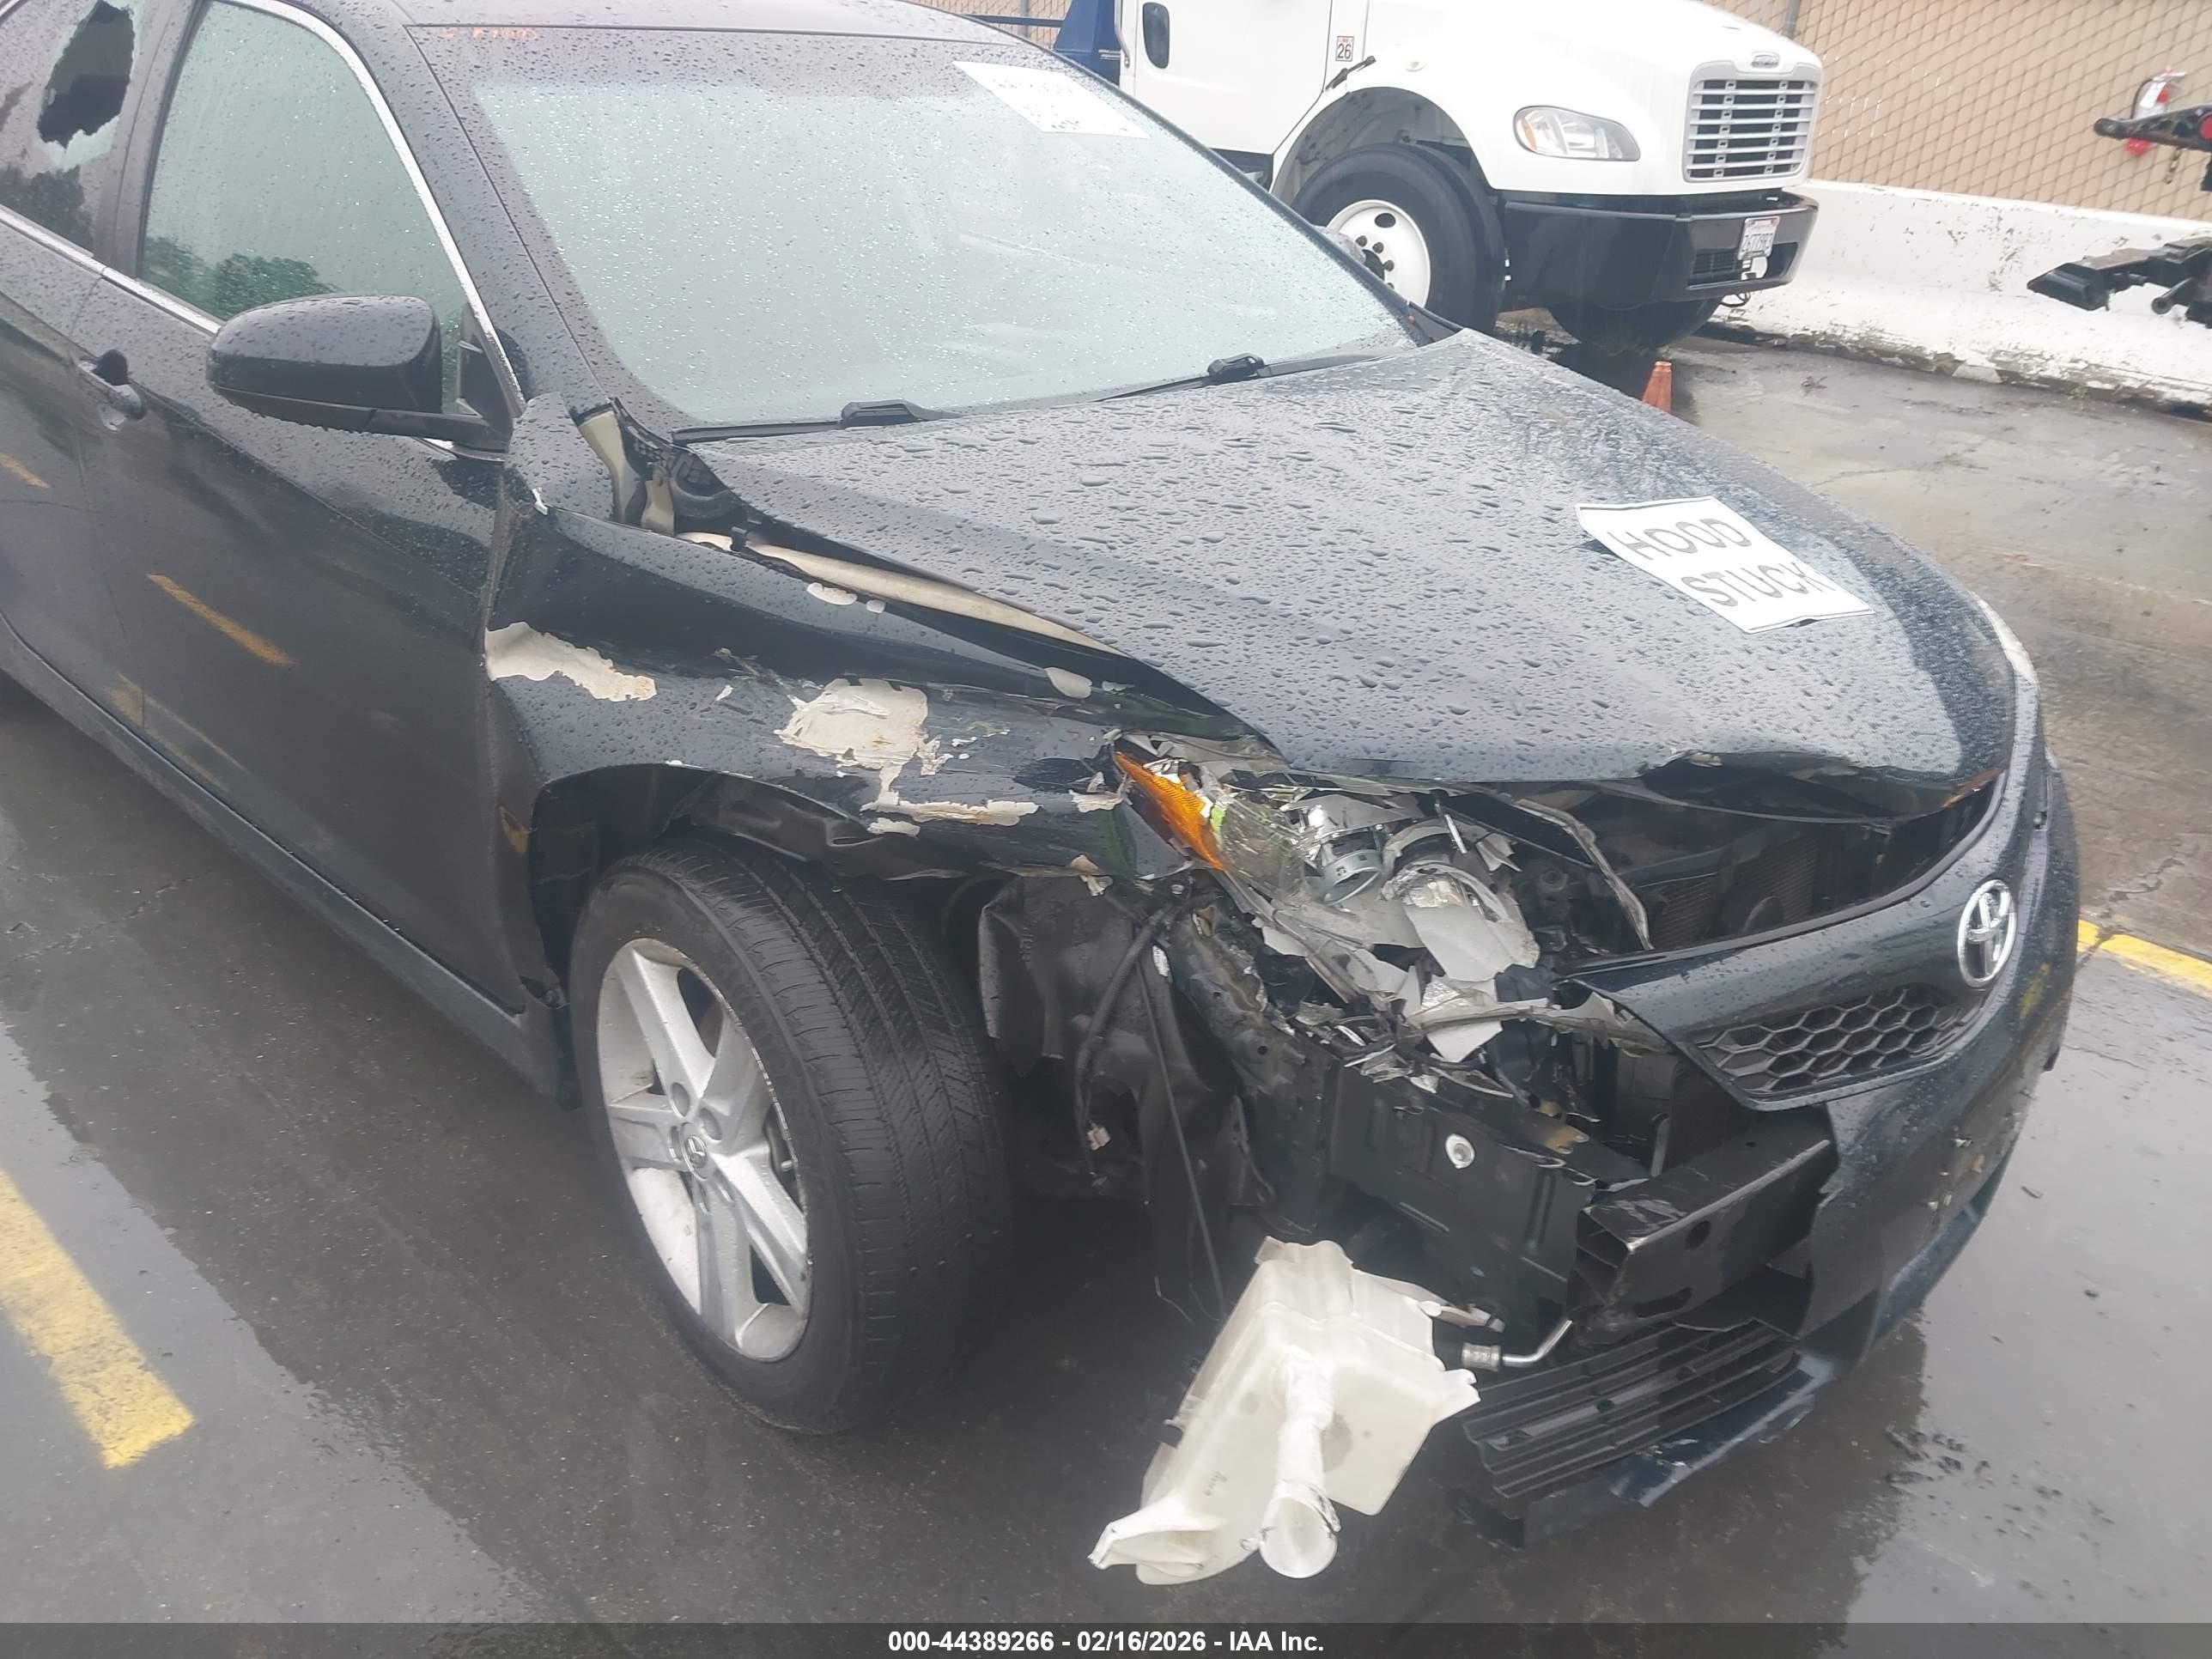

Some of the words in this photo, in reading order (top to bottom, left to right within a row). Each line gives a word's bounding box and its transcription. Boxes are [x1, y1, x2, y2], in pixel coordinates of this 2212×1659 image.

[1338, 44, 1352, 59] 26
[1607, 518, 1753, 561] HOOD
[1680, 561, 1837, 608] STUCK
